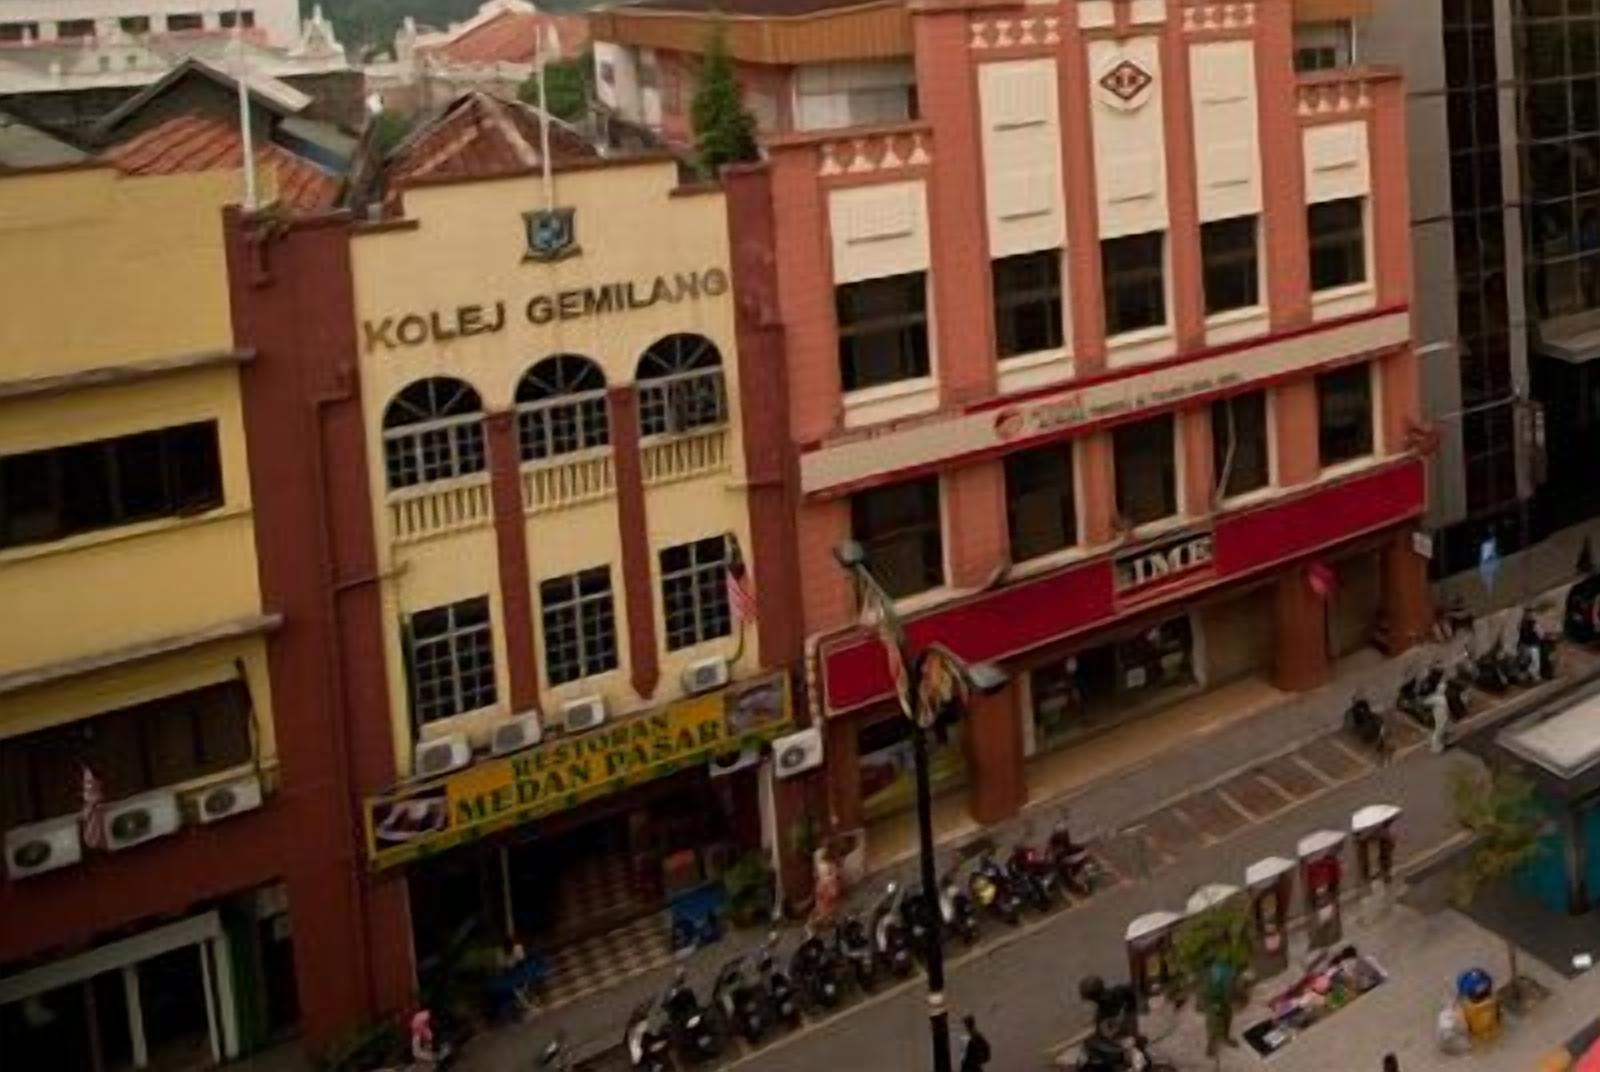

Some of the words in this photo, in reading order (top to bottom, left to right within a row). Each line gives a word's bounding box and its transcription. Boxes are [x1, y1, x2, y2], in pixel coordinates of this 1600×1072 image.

[364, 302, 506, 353] KOLEJ
[525, 268, 729, 324] GEMILANG
[456, 762, 591, 820] MEDAN
[605, 719, 721, 776] PASAR
[511, 712, 669, 779] RESTORAN
